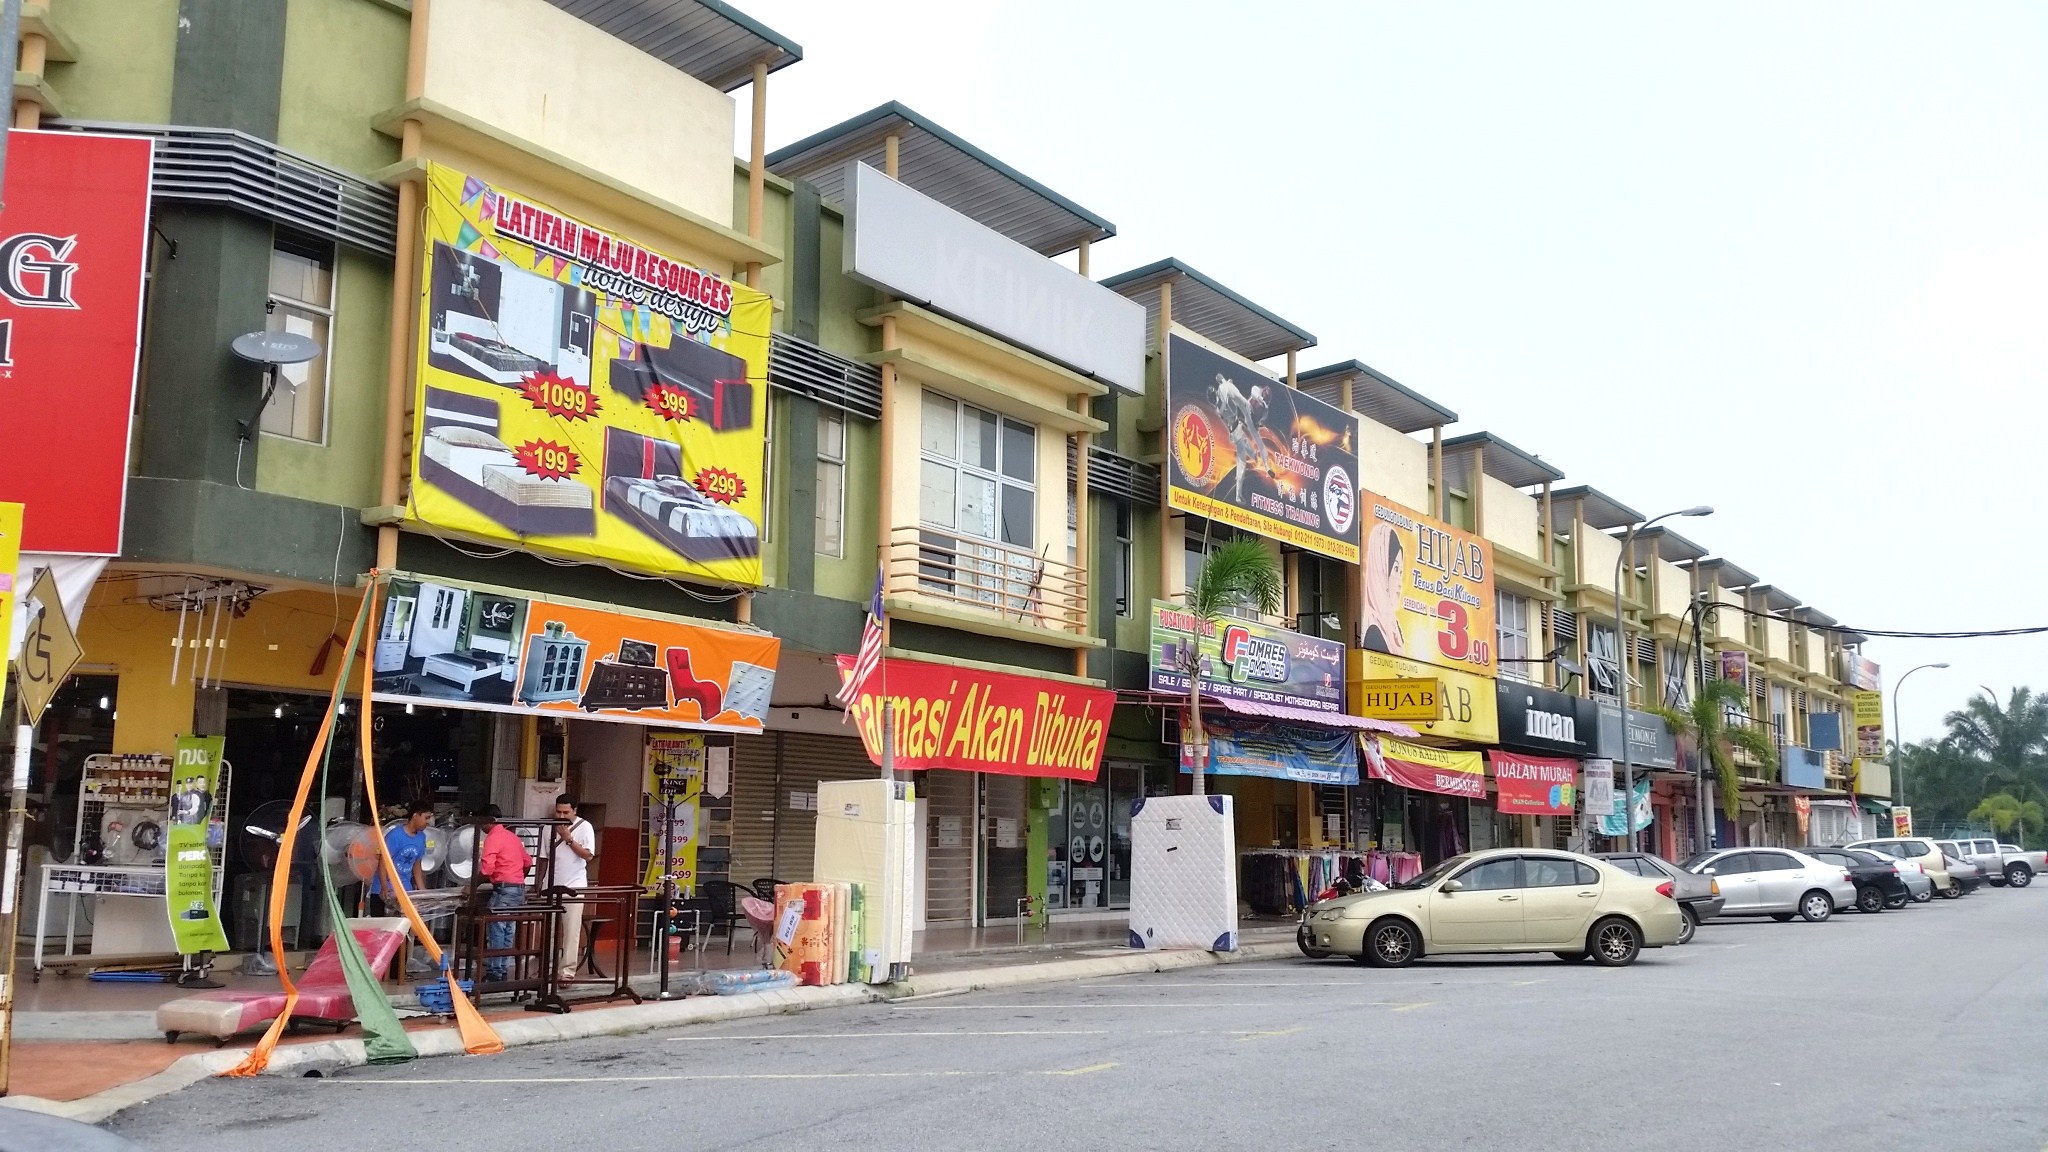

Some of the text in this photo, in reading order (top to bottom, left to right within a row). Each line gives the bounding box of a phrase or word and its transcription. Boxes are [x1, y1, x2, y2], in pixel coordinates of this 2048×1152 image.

[495, 194, 732, 313] LATIFAH MAJU RESOURCES
[582, 266, 717, 332] home design
[528, 381, 588, 414] RM 1099
[659, 389, 689, 416] 399
[523, 446, 568, 473] RM 199
[1274, 452, 1320, 481] TAEKWONDO
[708, 472, 738, 497] 299
[1174, 490, 1192, 507] Untuk
[1192, 497, 1224, 518] Keterangan
[1225, 507, 1229, 518] &
[1263, 520, 1273, 532] Sila
[1273, 523, 1293, 540] Hubungi
[1294, 530, 1313, 545] 012-211
[1313, 537, 1325, 550] 1973
[1251, 493, 1320, 529] FITNESS TRAINING
[1374, 504, 1395, 524] GEDUNG
[1415, 523, 1485, 583] HIJAB
[1413, 569, 1481, 608] Terus Dari Kilang
[1159, 608, 1180, 630] PUSAT
[1403, 597, 1427, 615] SERENDAH
[1437, 600, 1490, 665] 3.90
[1369, 655, 1418, 674] GEDUNG TUDUNG
[1158, 675, 1176, 686] SALE
[1212, 683, 1232, 695] SPARE
[1232, 686, 1248, 698] PART
[1253, 690, 1284, 703] SPECIALIST
[1284, 695, 1322, 709] MOTHERBOARD
[1321, 701, 1339, 712] REPAIR
[1367, 691, 1434, 711] HIJAB
[1498, 684, 1510, 694] BUTIK
[843, 669, 958, 760] armasi
[945, 682, 1024, 765] Akan
[1026, 690, 1103, 772] Dibuka
[1525, 695, 1576, 742] iman
[1389, 740, 1418, 758] BONUS
[1435, 773, 1472, 792] BERMINAT
[1496, 761, 1538, 780] JUALAN
[1540, 765, 1573, 782] MURAH
